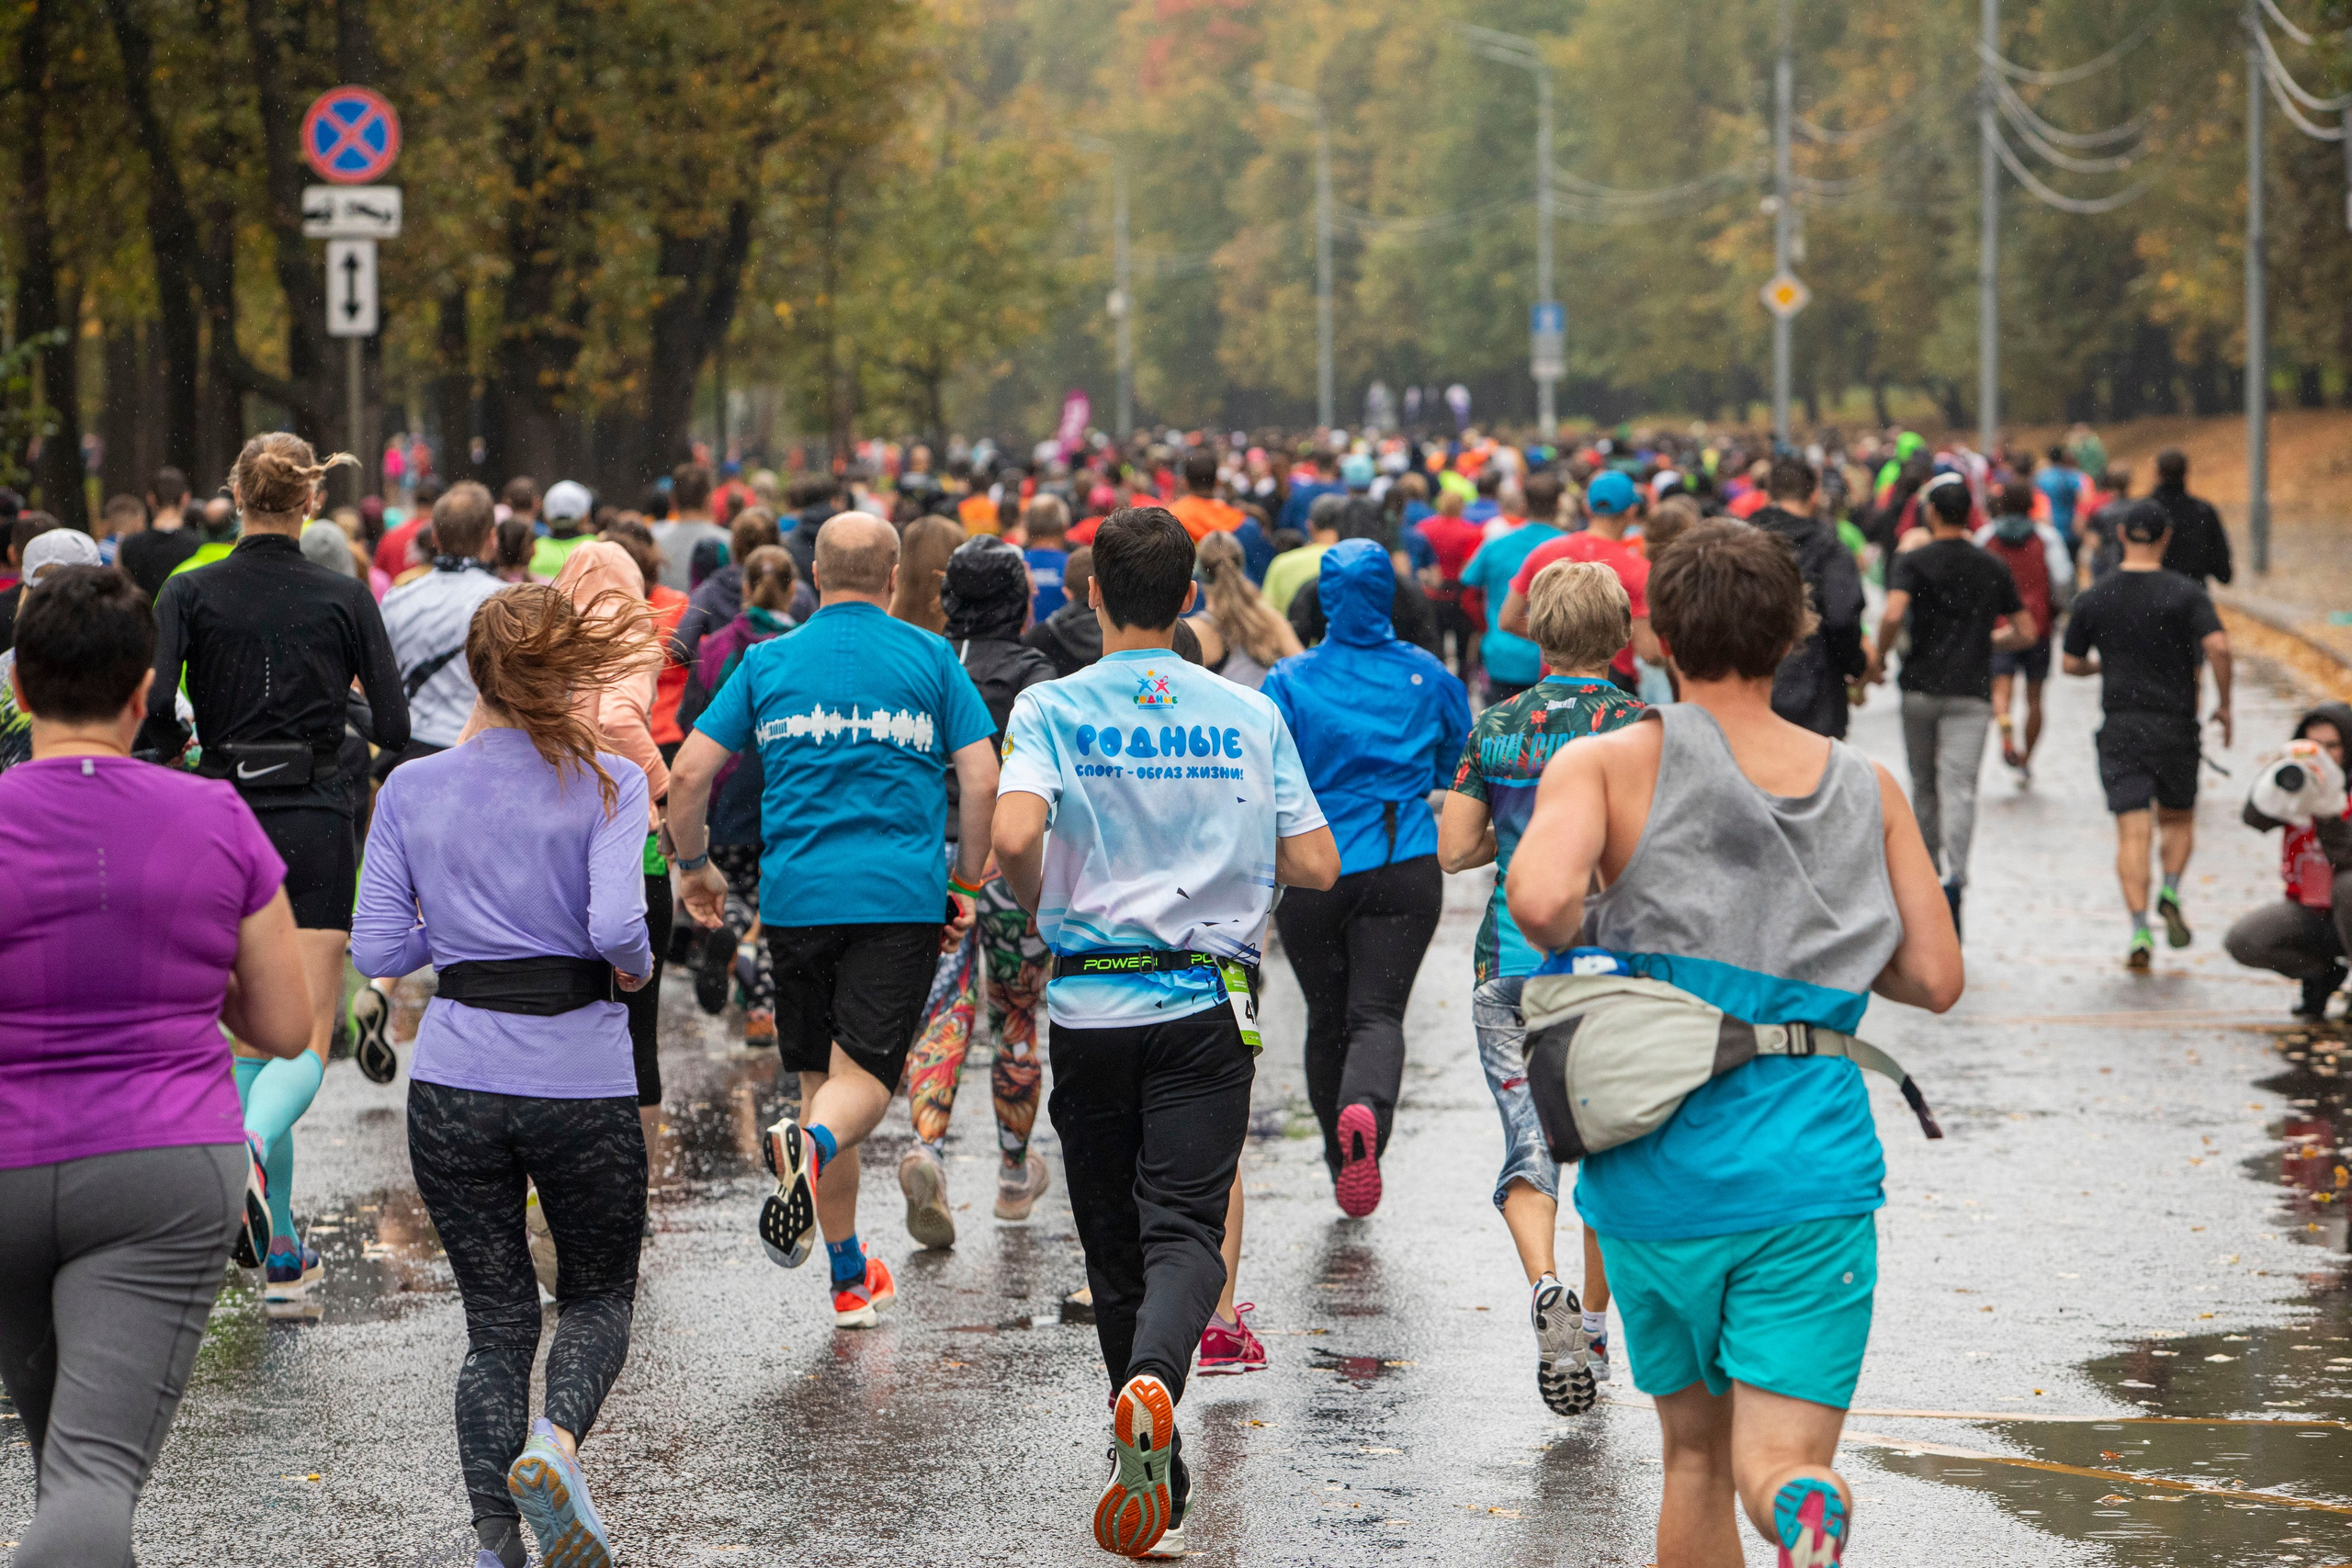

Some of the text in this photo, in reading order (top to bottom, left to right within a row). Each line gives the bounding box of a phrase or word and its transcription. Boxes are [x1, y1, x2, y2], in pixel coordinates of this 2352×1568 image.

[1133, 694, 1178, 705] РОДНЫЕ
[1076, 724, 1243, 759] РОДНЫЕ
[1075, 764, 1124, 778] СПОРТ
[1136, 766, 1182, 780] ОБРАЗ
[1186, 765, 1244, 780] ЖИЗНИ!
